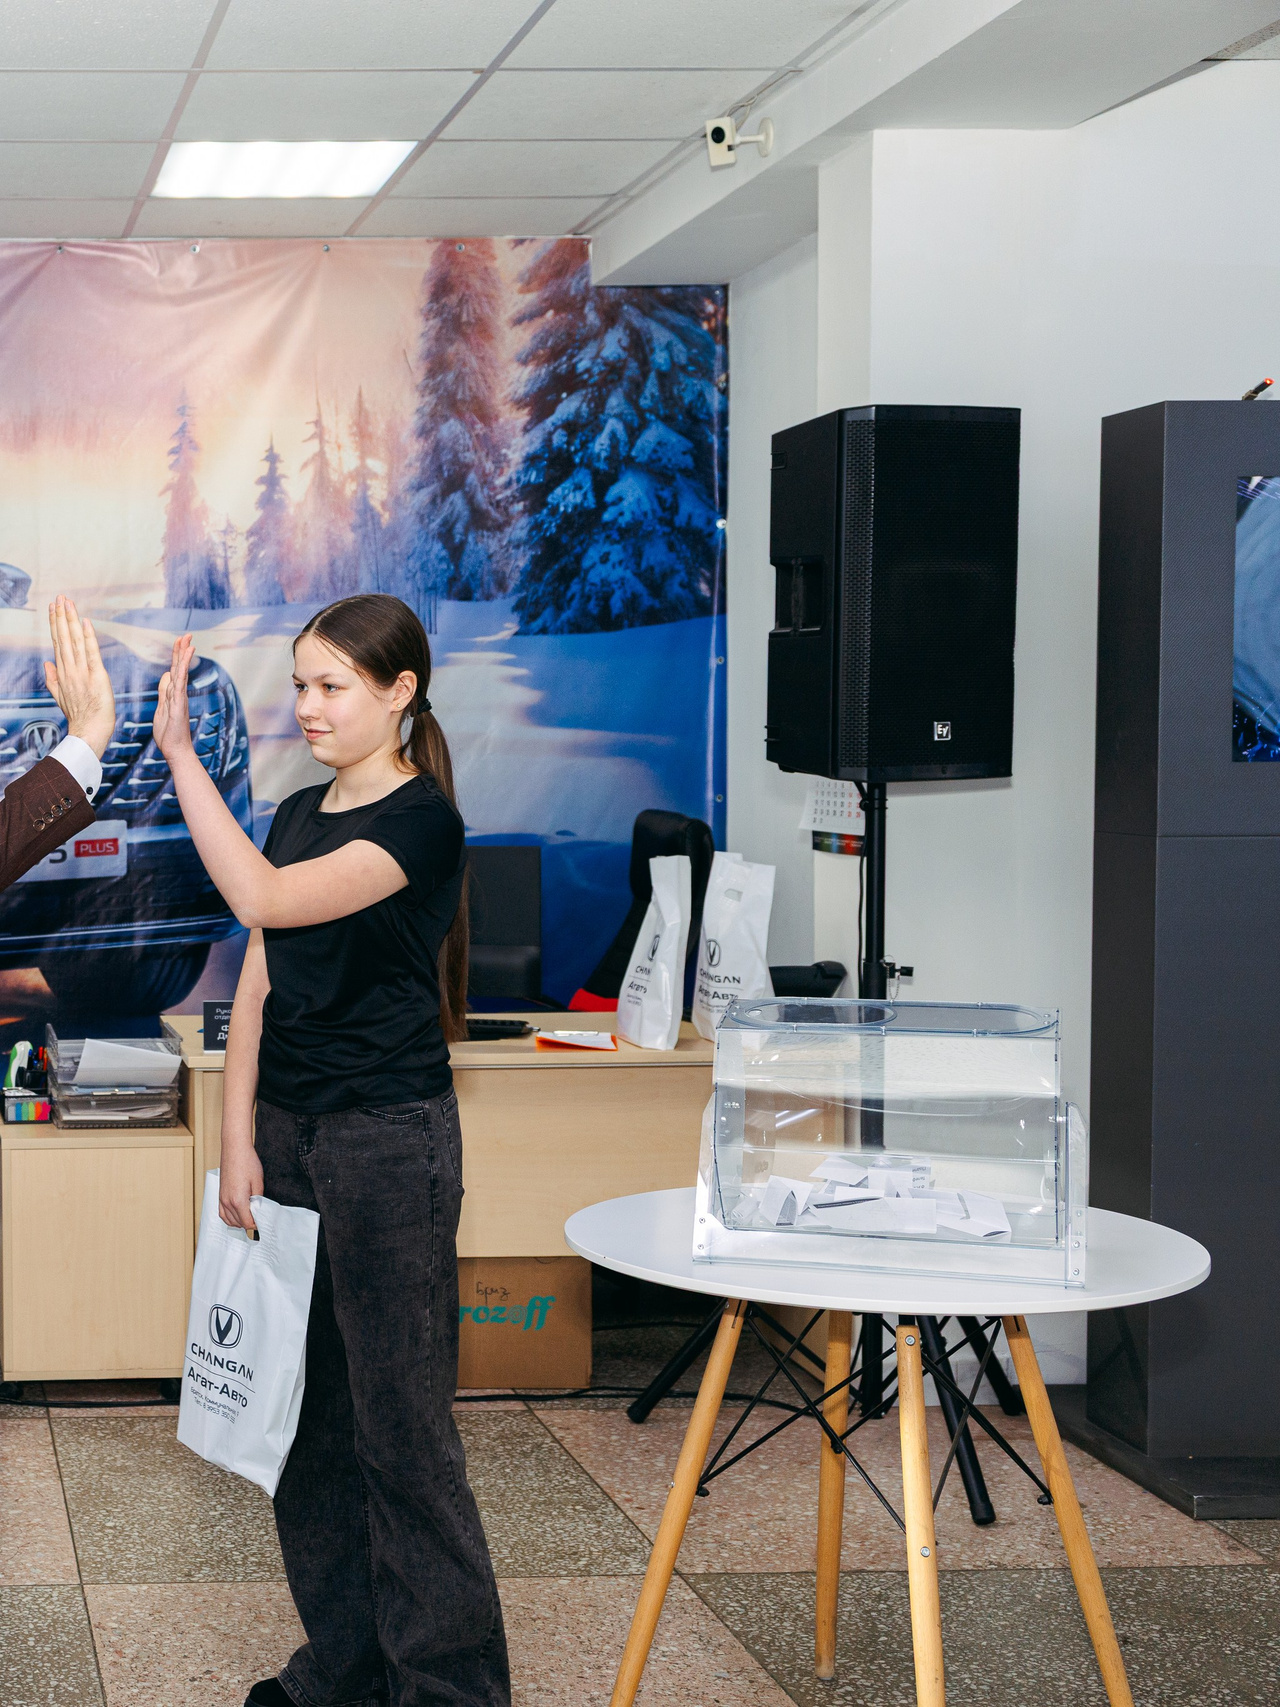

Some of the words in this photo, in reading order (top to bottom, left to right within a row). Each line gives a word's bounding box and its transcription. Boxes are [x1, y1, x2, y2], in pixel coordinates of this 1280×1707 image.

[80, 842, 114, 853] PLUS
[191, 1343, 253, 1381] CHANGAN
[188, 1367, 248, 1407] Агат-Авто
